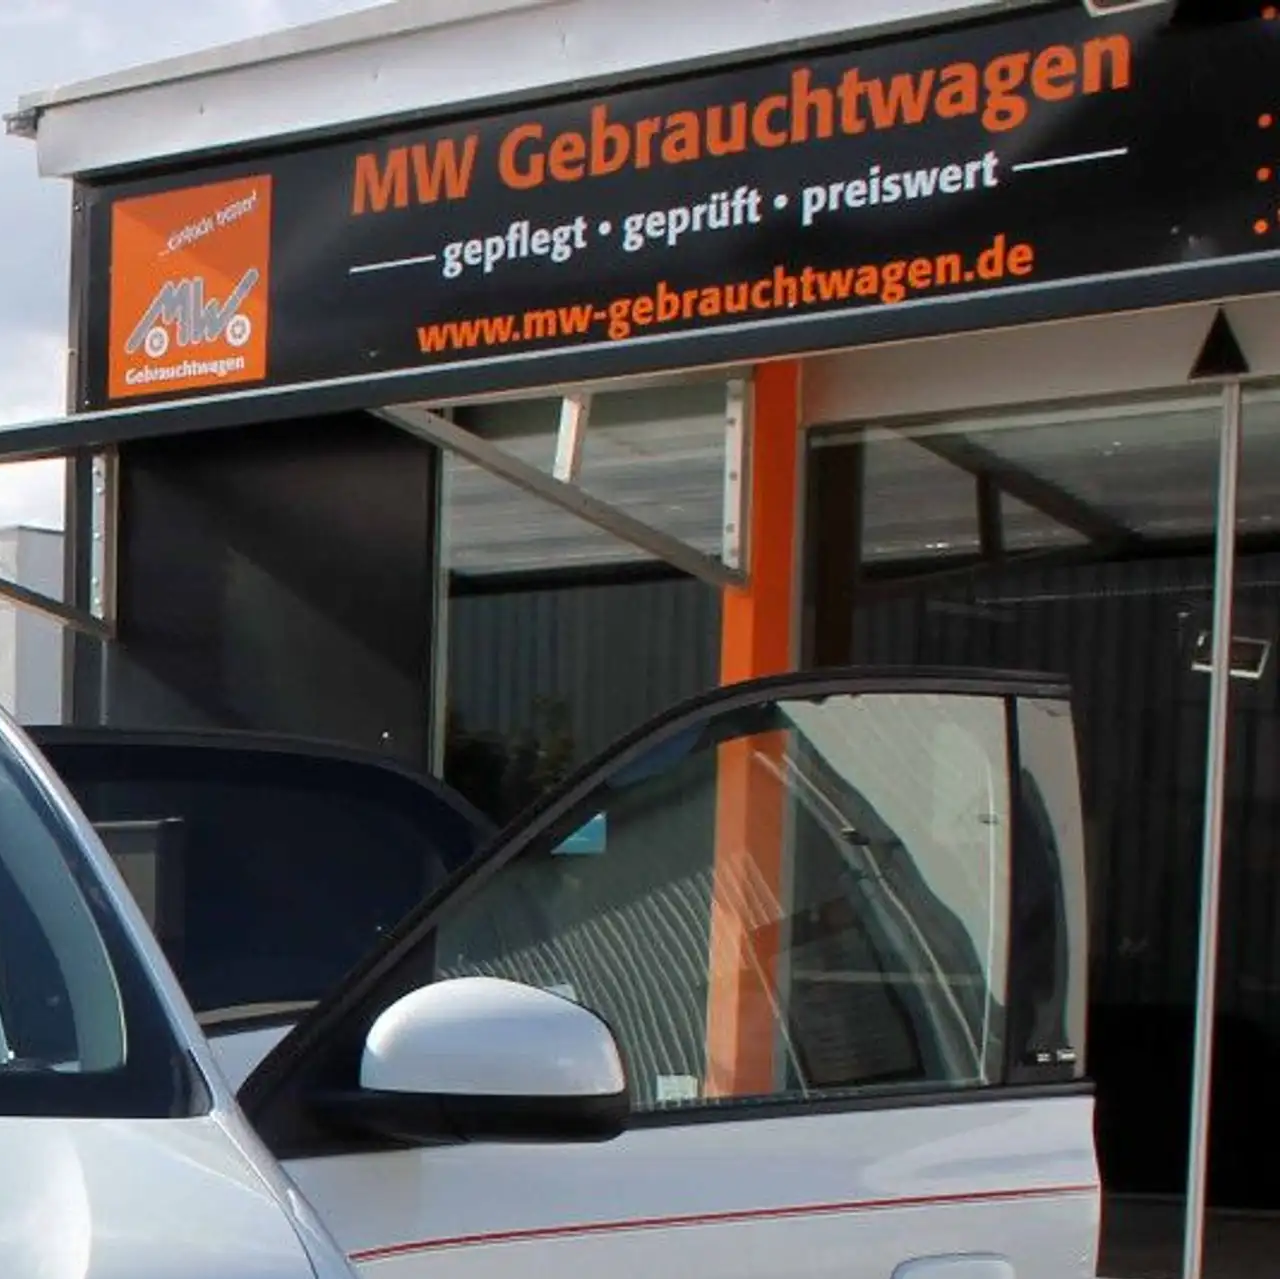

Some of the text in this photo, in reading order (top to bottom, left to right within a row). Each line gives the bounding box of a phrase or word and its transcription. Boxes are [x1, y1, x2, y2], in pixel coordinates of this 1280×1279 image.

[351, 33, 1131, 214] MW Gebrauchtwagen
[442, 148, 1000, 278] gepflegt geprüft preiswert
[417, 235, 1034, 353] www.mw-gebrauchtwagen.de
[124, 355, 246, 385] Gebrauchtwagen
